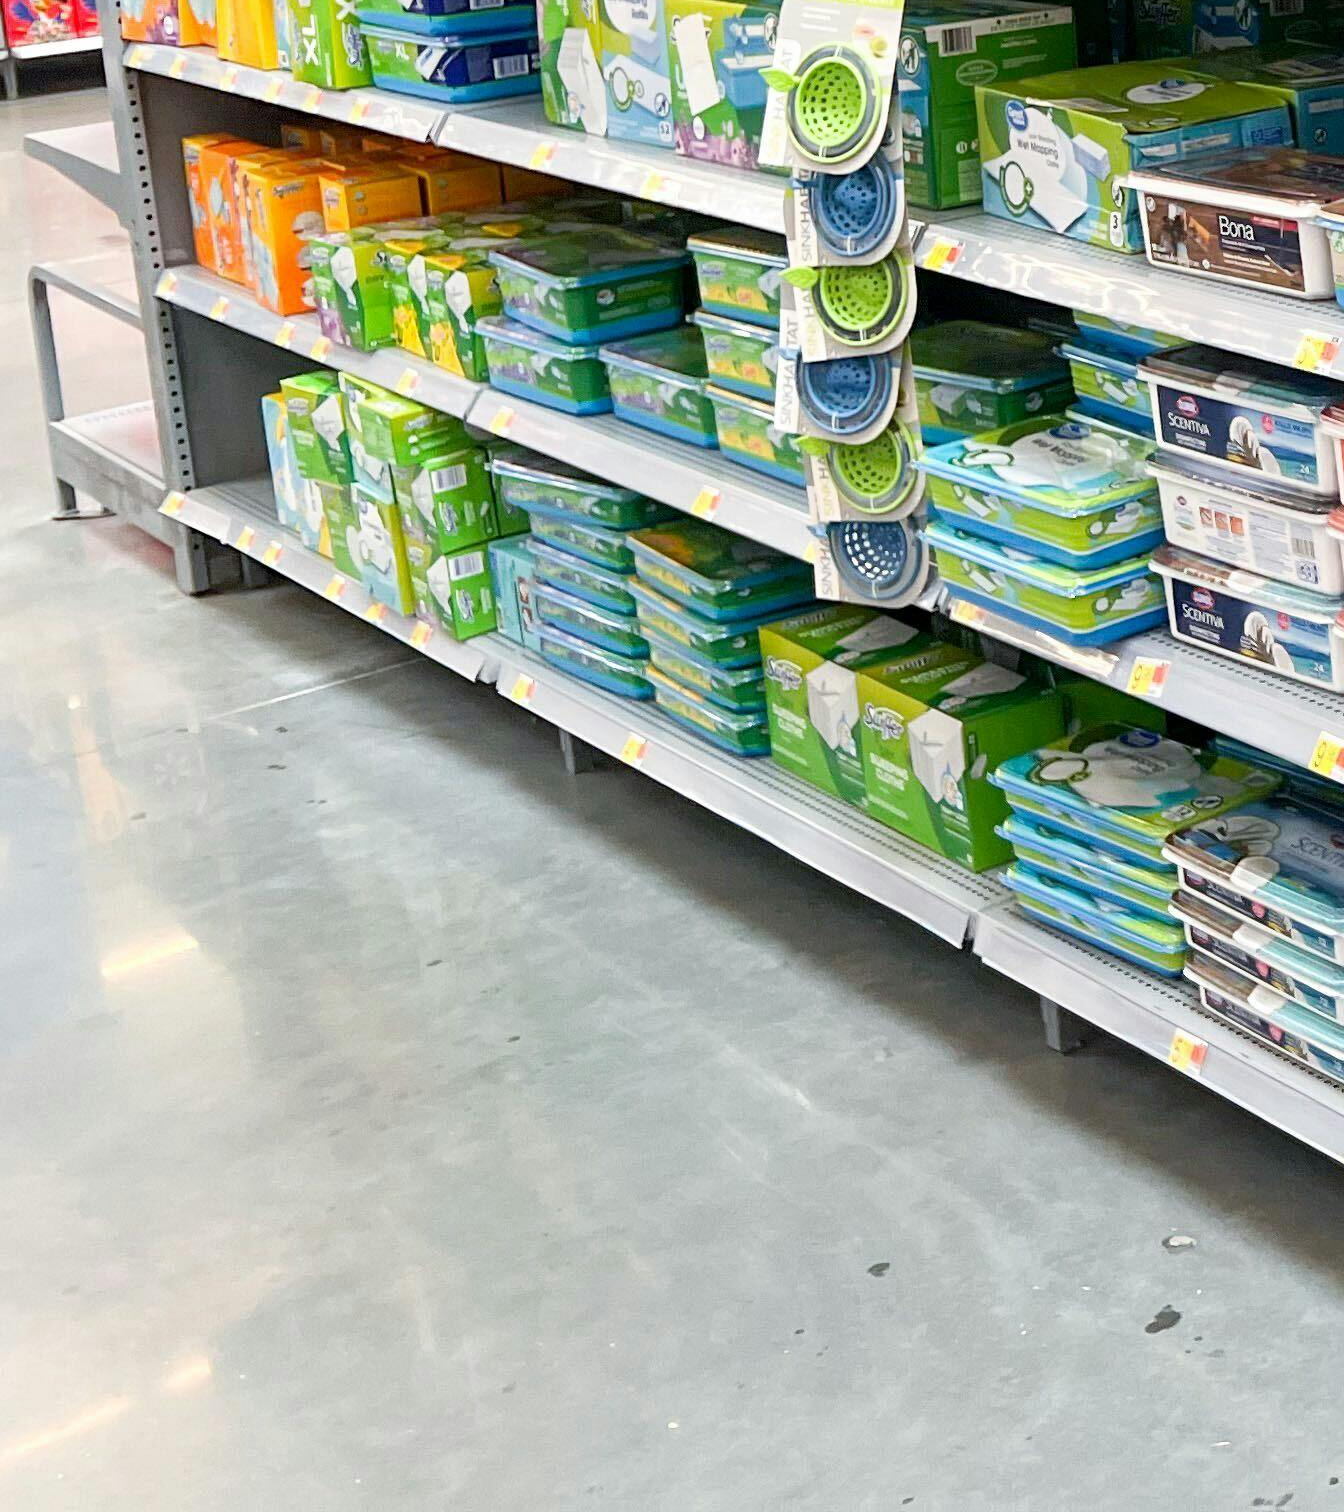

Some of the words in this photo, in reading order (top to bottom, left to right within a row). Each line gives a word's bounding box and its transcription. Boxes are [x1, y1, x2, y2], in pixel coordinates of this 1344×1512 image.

[301, 29, 320, 65] XL
[1219, 216, 1255, 241] Bona
[1168, 413, 1211, 438] SCENTIVA
[1182, 604, 1224, 629] SCENTIVA
